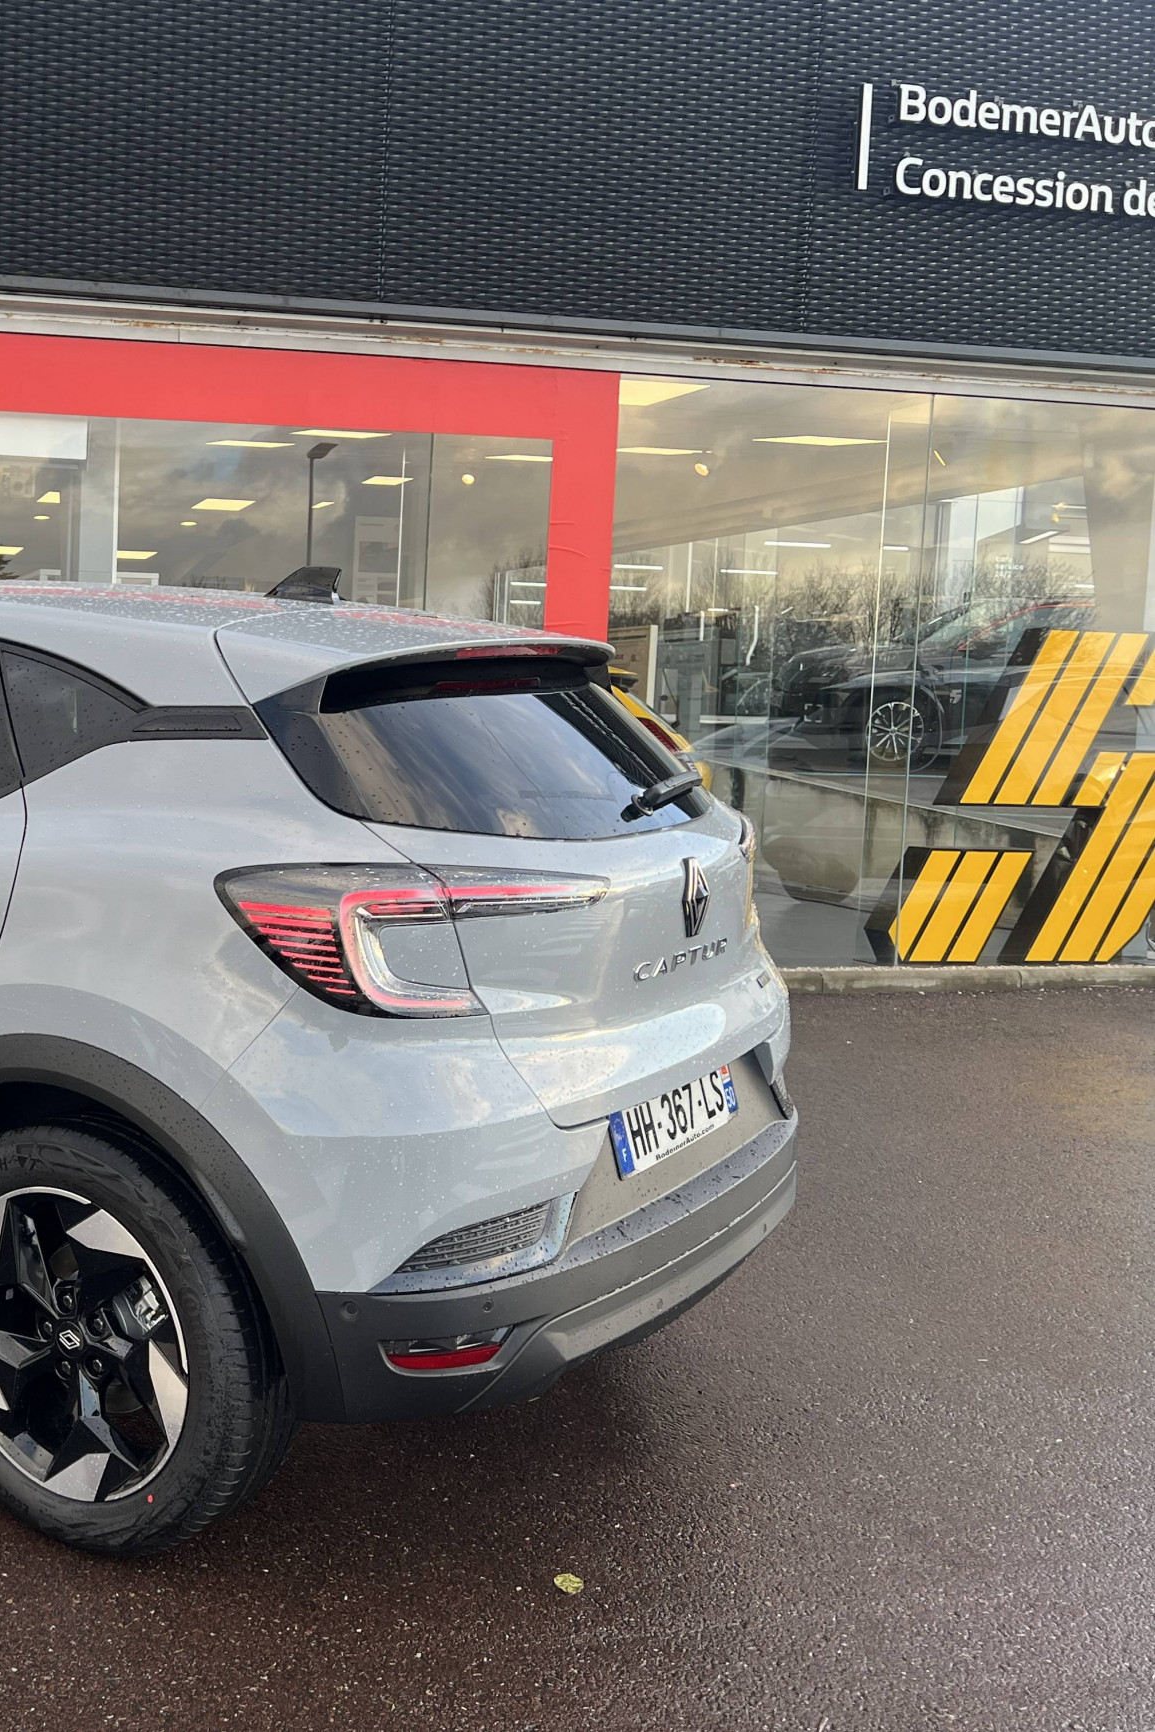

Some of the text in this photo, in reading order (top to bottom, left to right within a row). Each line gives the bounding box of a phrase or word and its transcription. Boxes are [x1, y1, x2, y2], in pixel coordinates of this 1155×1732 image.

[899, 83, 1155, 148] BodemerAuto
[895, 156, 1114, 213] Concession
[633, 938, 728, 983] CAPTUR
[621, 1071, 737, 1163] F HH-367-LS 50
